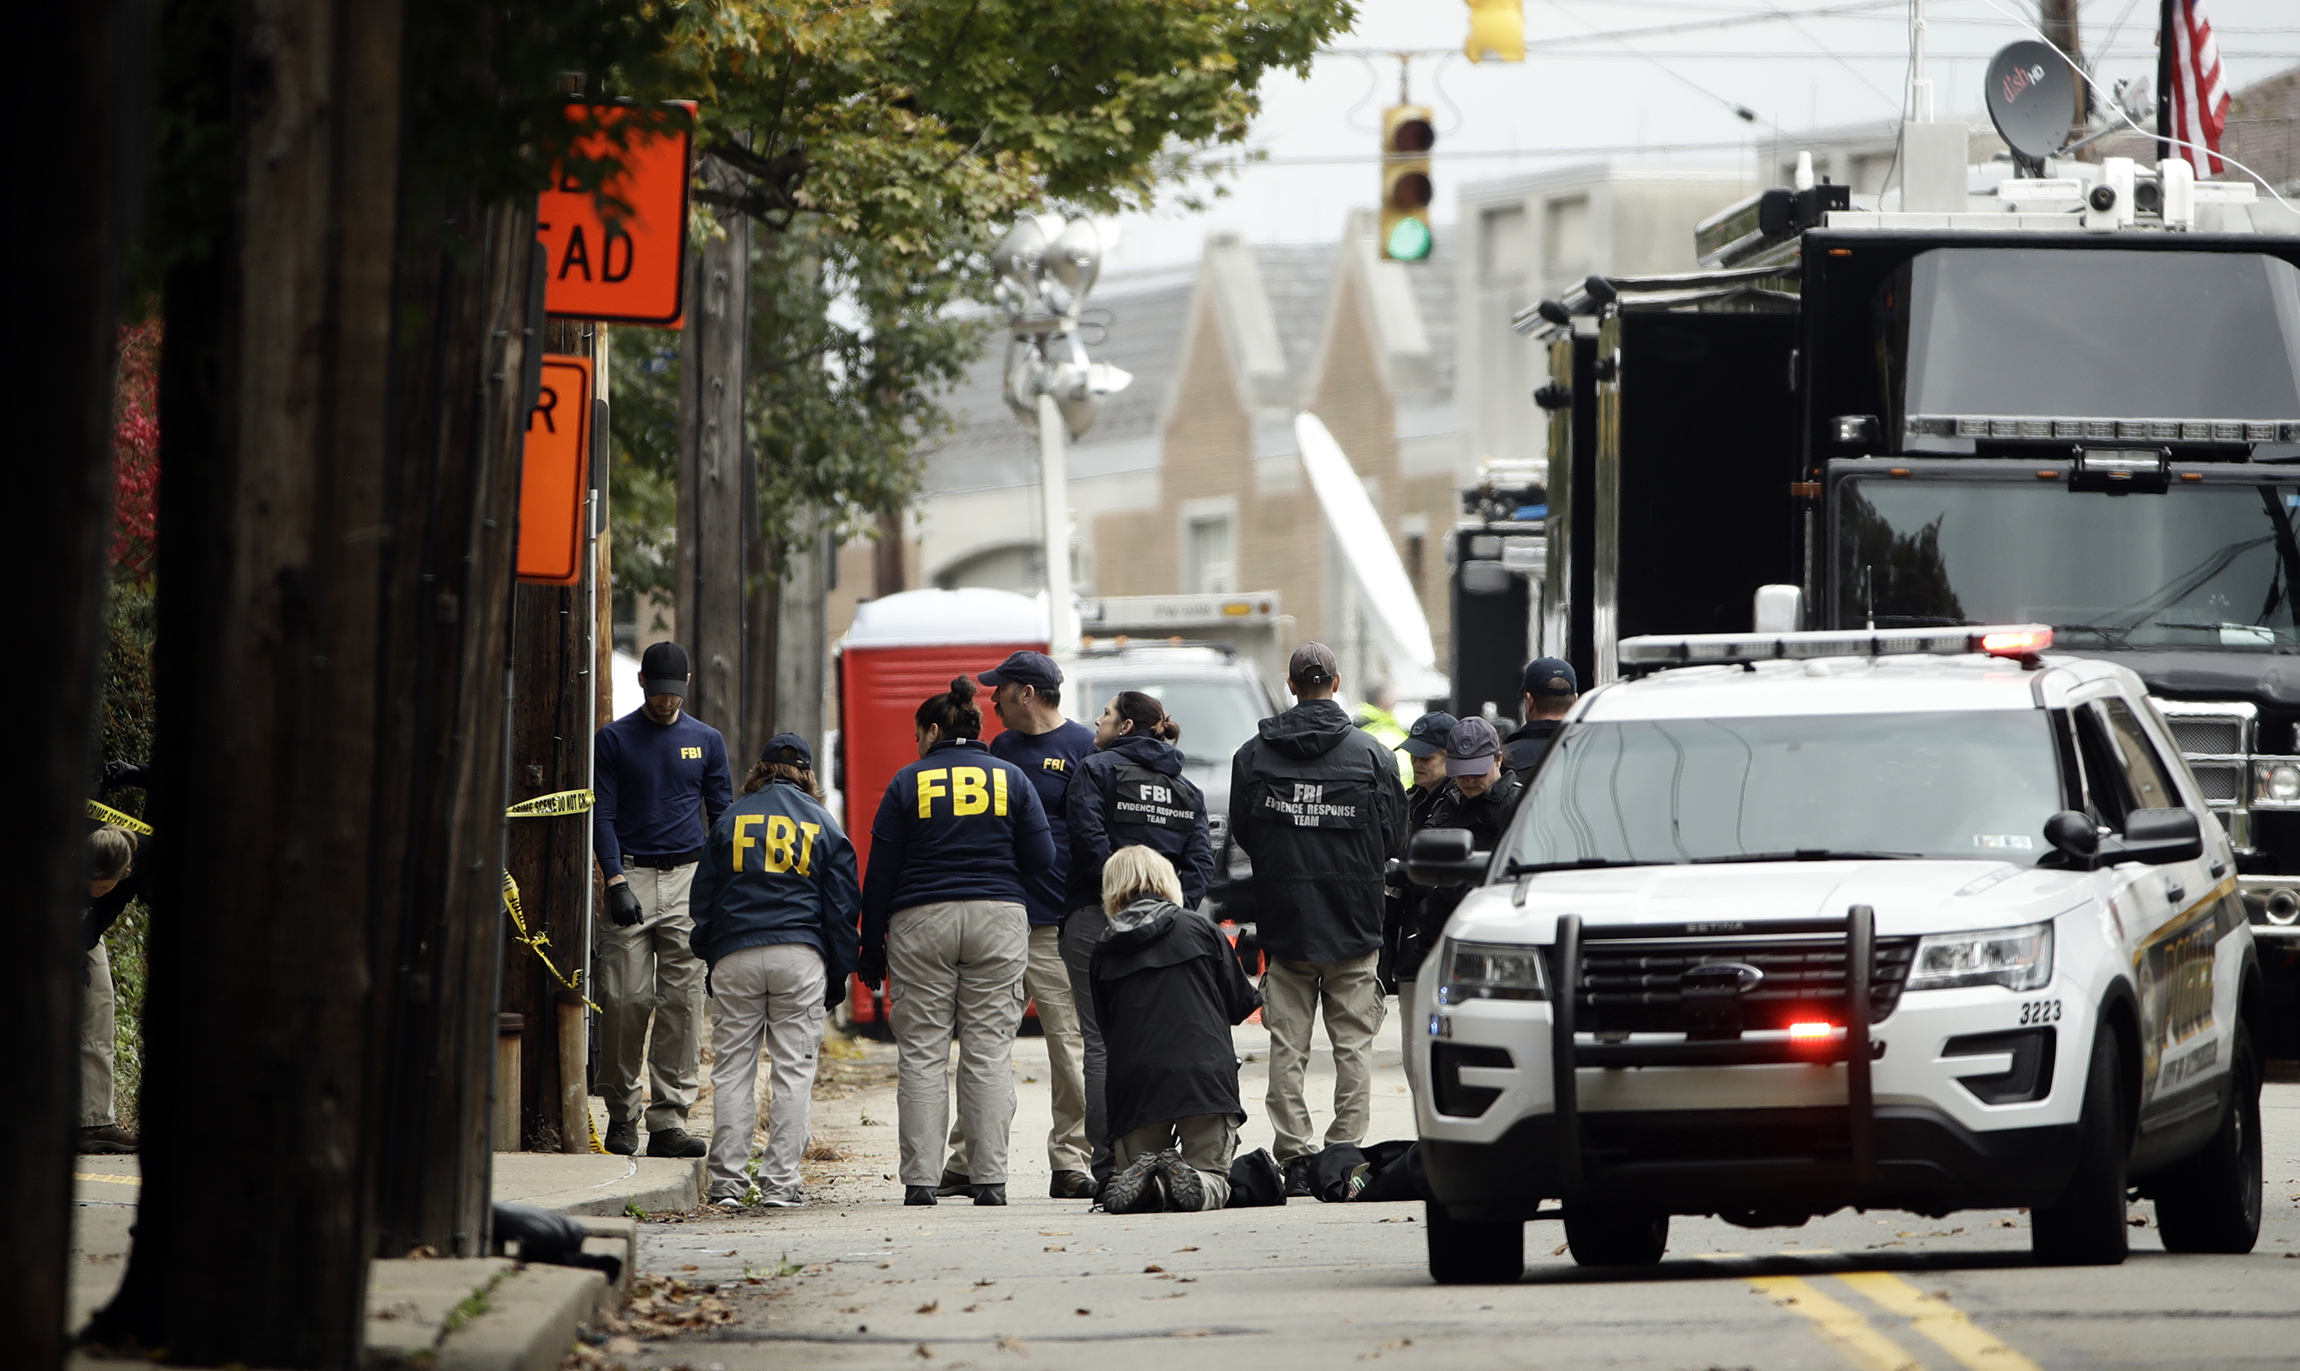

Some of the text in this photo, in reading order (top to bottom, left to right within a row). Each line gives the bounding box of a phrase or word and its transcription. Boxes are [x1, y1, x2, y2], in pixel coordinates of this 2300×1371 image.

[2027, 64, 2045, 86] HD
[538, 222, 633, 283] AD
[680, 747, 702, 759] FBI
[1043, 758, 1066, 772] FBI
[566, 793, 577, 811] NOT
[917, 766, 1008, 819] FBI
[1140, 784, 1172, 804] FBI
[1293, 783, 1323, 804] FBI
[1117, 801, 1195, 820] EVIDENCE RESPONSE
[1147, 814, 1166, 825] TEAM
[1307, 803, 1356, 818] RESPONSE
[1294, 814, 1320, 827] TEAM
[732, 814, 820, 878] FBI
[2020, 1000, 2061, 1025] 3223
